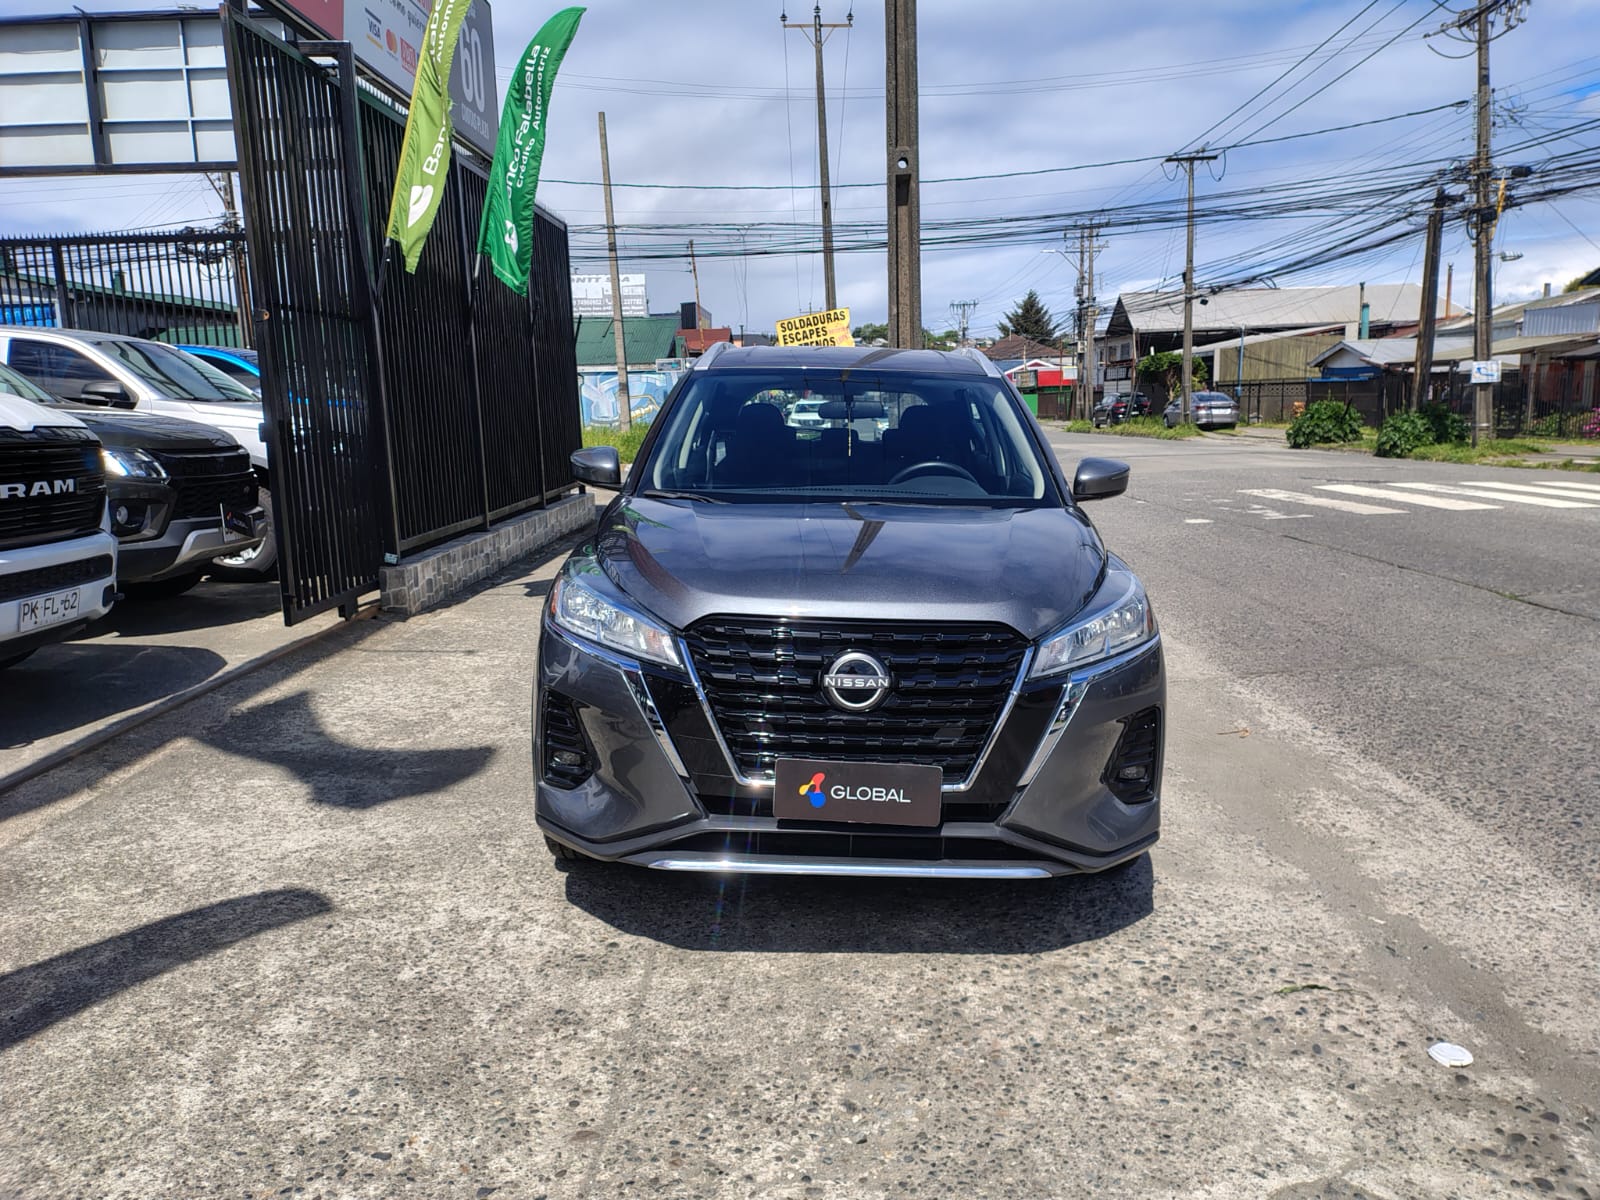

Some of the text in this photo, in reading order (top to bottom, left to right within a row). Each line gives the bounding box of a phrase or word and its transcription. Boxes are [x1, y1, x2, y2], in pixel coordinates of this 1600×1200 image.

[367, 18, 381, 39] VISA
[460, 18, 485, 112] 60
[515, 45, 541, 145] Falabella
[532, 46, 551, 130] Automotriz
[780, 310, 846, 333] SOLDADURAS
[782, 326, 828, 345] ESCAPES
[0, 479, 75, 499] RAM
[824, 677, 889, 687] NISSAN
[830, 785, 912, 803] GLOBAL
